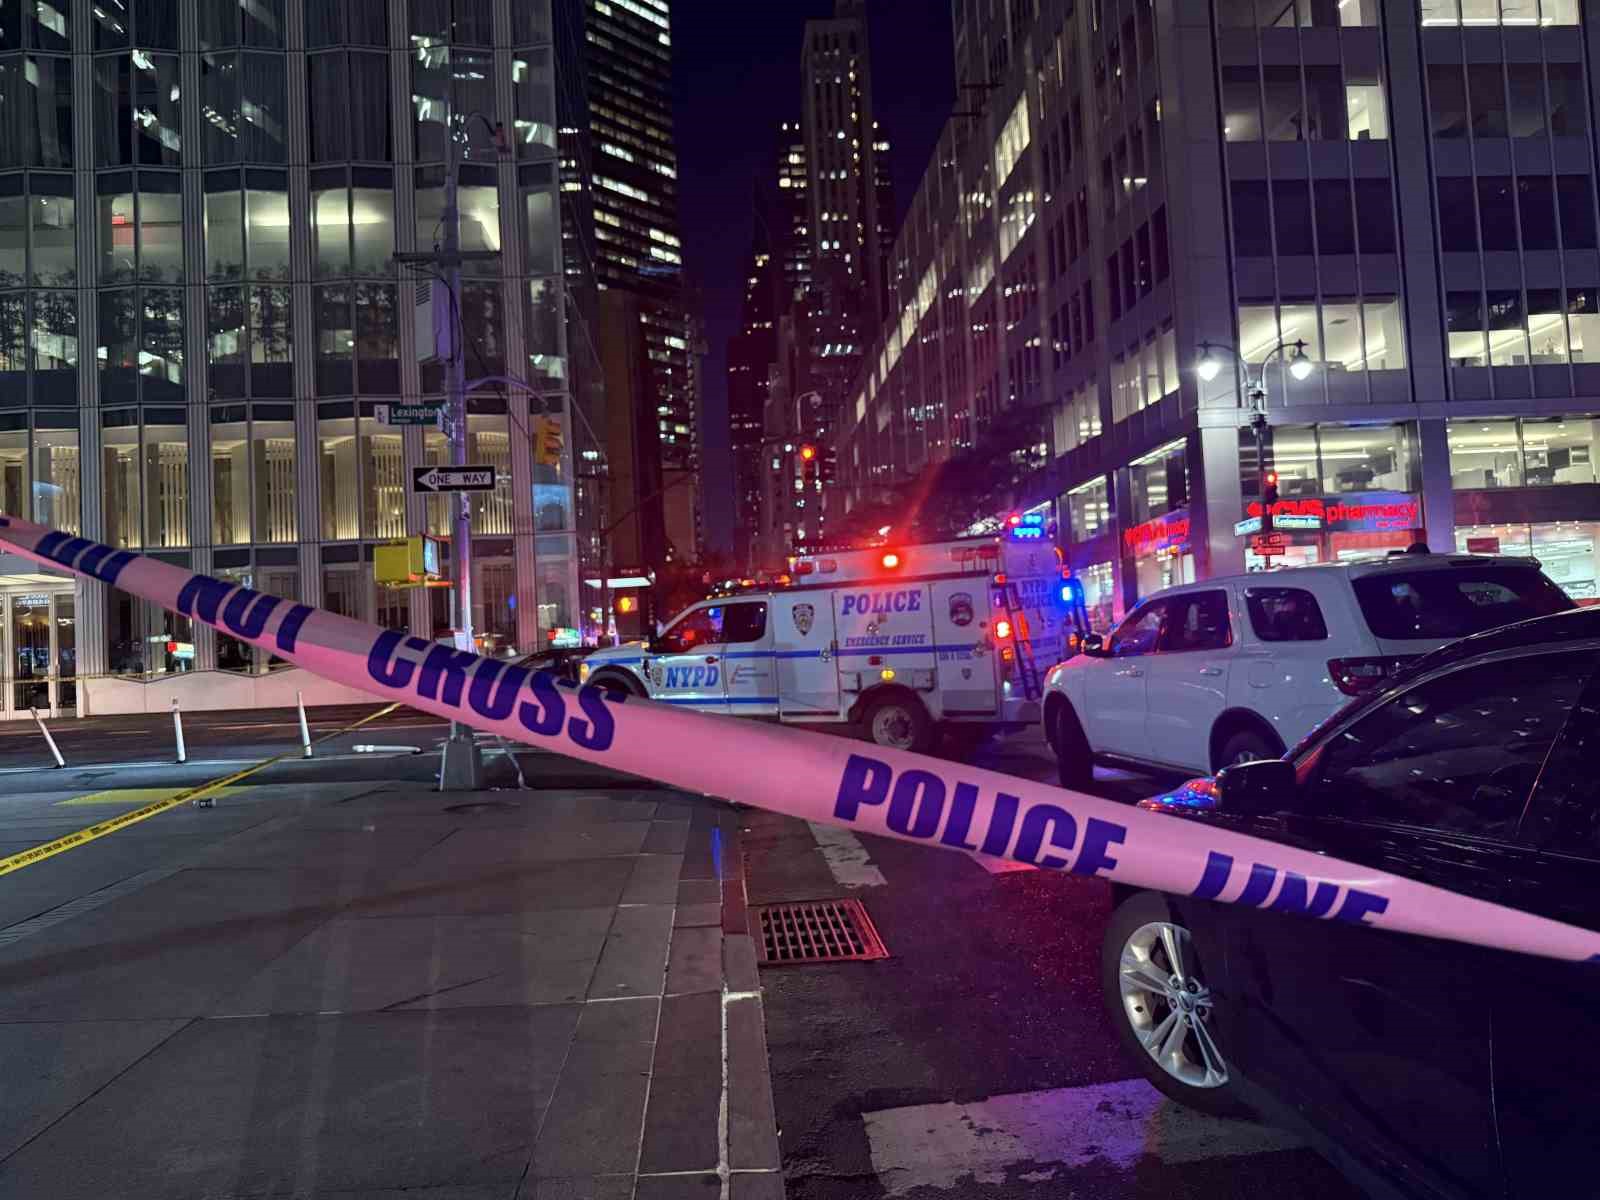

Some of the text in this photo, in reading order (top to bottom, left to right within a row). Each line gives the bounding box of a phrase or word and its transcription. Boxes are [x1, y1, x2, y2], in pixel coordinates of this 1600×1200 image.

[428, 473, 487, 485] ONE WAY
[1327, 502, 1417, 525] pharmacy
[841, 589, 922, 616] POLICE
[666, 666, 719, 688] NYPD
[367, 630, 615, 751] CROSS
[833, 754, 1127, 876] POLICE
